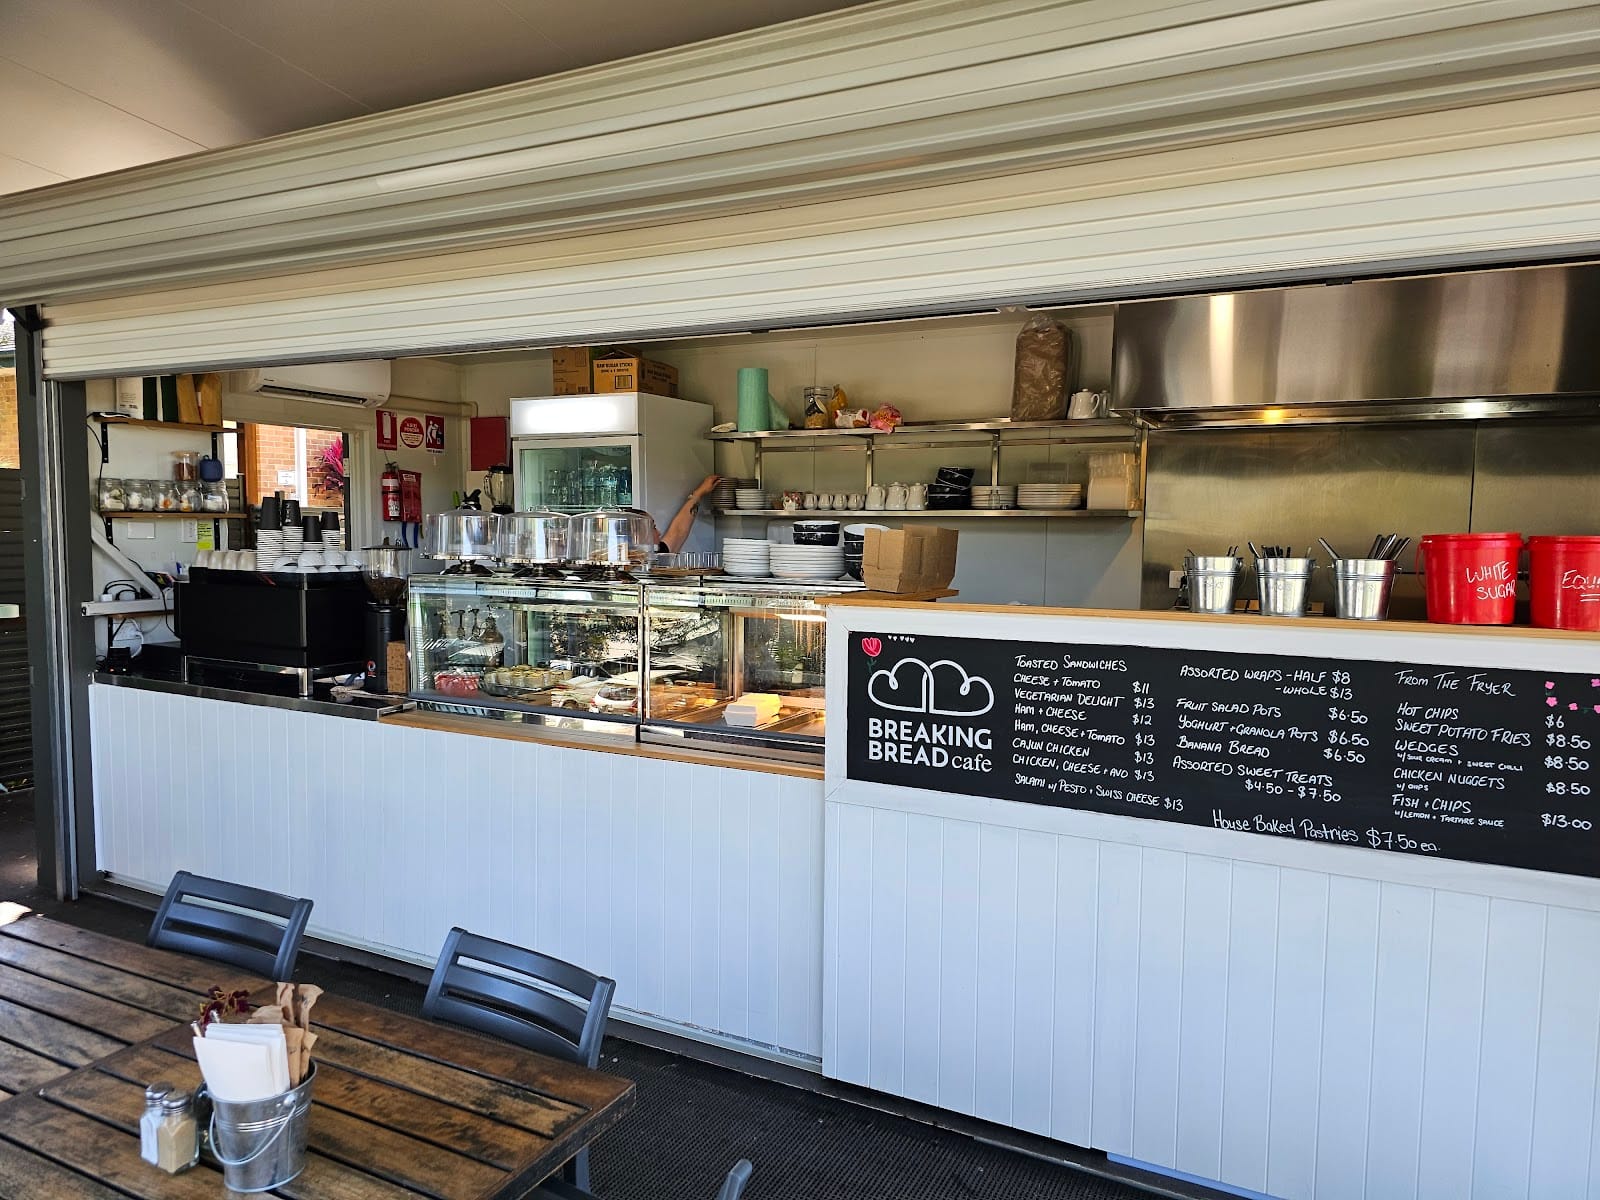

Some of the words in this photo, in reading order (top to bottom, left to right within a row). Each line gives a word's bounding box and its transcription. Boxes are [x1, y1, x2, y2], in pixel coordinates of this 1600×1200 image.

[1466, 560, 1511, 583] WHITE
[1477, 580, 1516, 600] SUGAR
[1014, 655, 1058, 670] TOASTED
[1063, 655, 1128, 672] SANDWICHES
[1014, 673, 1050, 686] CHEESE
[1062, 676, 1100, 689] TOMATO
[1180, 665, 1239, 681] ASSORTED
[1243, 669, 1283, 682] WRAPS
[1332, 670, 1350, 685] $8
[1394, 669, 1428, 686] FROM
[1433, 672, 1460, 690] THE
[1466, 673, 1516, 697] FRYER
[1133, 681, 1149, 694] $11
[1330, 687, 1353, 700] $13
[1014, 688, 1073, 702] VEGETARIAN
[1077, 693, 1125, 707] DELIGHT
[1134, 697, 1155, 709] $13
[1015, 703, 1034, 715] HAM
[1046, 706, 1087, 720] CHEESE
[1176, 698, 1208, 712] FRUIT
[1212, 702, 1249, 713] SALAD
[1252, 704, 1282, 718] POTS
[1396, 702, 1422, 716] HOT
[1425, 708, 1459, 720] CHIPS
[1133, 713, 1152, 725] $12
[1178, 715, 1229, 732] YOGHURT
[1288, 726, 1318, 742] POTS
[1545, 714, 1564, 728] $6
[868, 717, 992, 750] BREAKING
[1014, 719, 1038, 735] HAM,
[1041, 723, 1079, 738] CHEESE
[1086, 729, 1125, 745] TOMATO
[1135, 732, 1155, 746] $13
[1395, 719, 1439, 735] SWEET
[1438, 725, 1487, 741] POTATO
[1491, 728, 1531, 746] FRIES
[1012, 738, 1044, 751] CAJUN
[1046, 742, 1090, 757] CHICKEN
[1177, 735, 1222, 752] BANANA
[1228, 740, 1269, 758] BREAD
[1395, 740, 1459, 756] WEDGES
[868, 740, 948, 768] BREAD
[951, 752, 992, 773] cafe
[1012, 754, 1059, 770] CHICKEN,
[1062, 760, 1101, 774] CHEESE
[1110, 768, 1128, 778] AVO
[1135, 751, 1154, 764] $13
[1135, 770, 1155, 782] $13
[1173, 755, 1233, 776] ASSORTED
[1237, 764, 1284, 778] SWEET
[1285, 770, 1333, 786] TREATS
[1394, 767, 1443, 782] CHICKEN
[1447, 773, 1505, 790] NUGGETS
[1014, 773, 1045, 787] SALAMI
[1058, 778, 1087, 794] PESTO
[1095, 785, 1123, 800] SWISS
[1126, 792, 1160, 806] CHEESE
[1164, 797, 1184, 812] $13
[1392, 794, 1419, 808] FISH
[1432, 798, 1472, 813] CHIPS
[1212, 808, 1251, 832] House
[1253, 814, 1295, 835] Baked
[1300, 818, 1359, 842] Pastries
[1478, 819, 1504, 827] SAUCE
